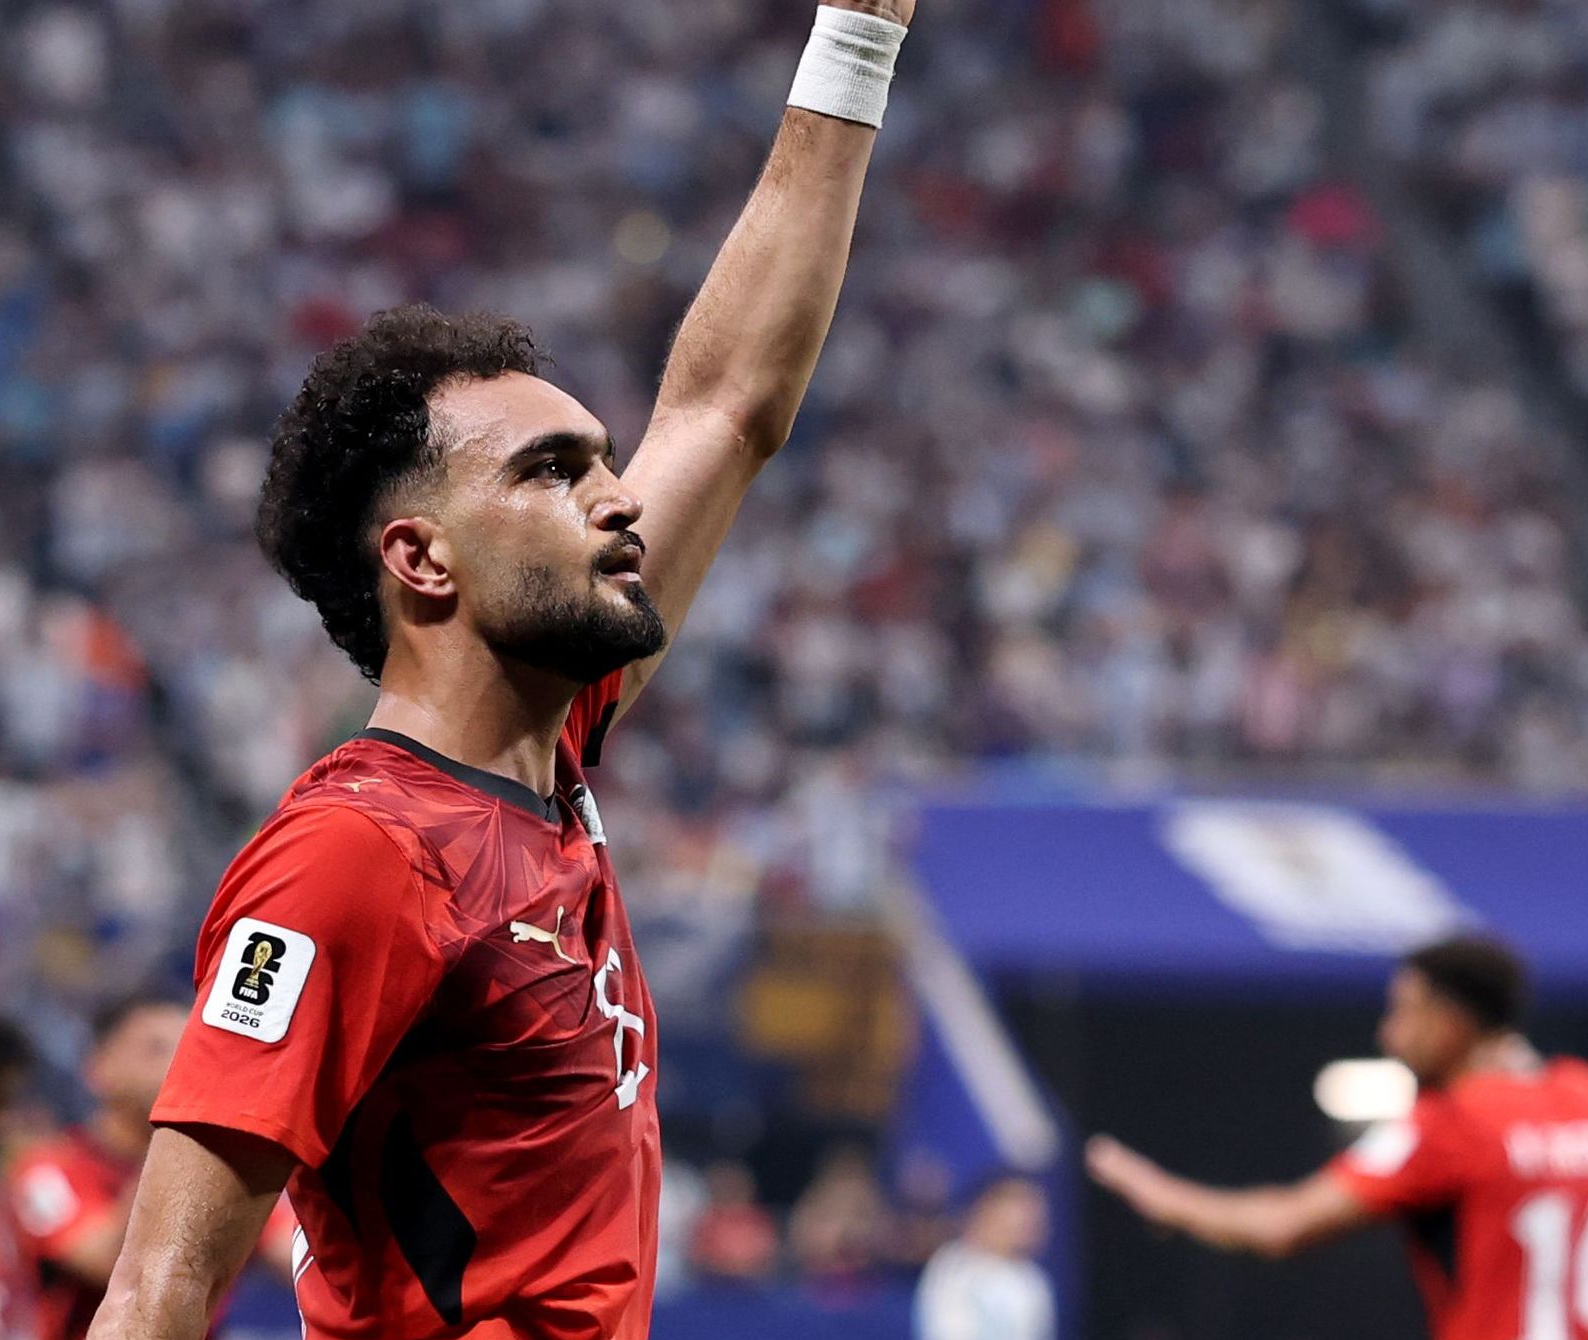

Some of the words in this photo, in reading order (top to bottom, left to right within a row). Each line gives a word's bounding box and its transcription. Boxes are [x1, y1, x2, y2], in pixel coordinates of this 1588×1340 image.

[238, 985, 259, 1000] FIFA
[225, 1001, 249, 1013] WORLD
[247, 1007, 265, 1018] CUP
[220, 1008, 262, 1029] 2026
